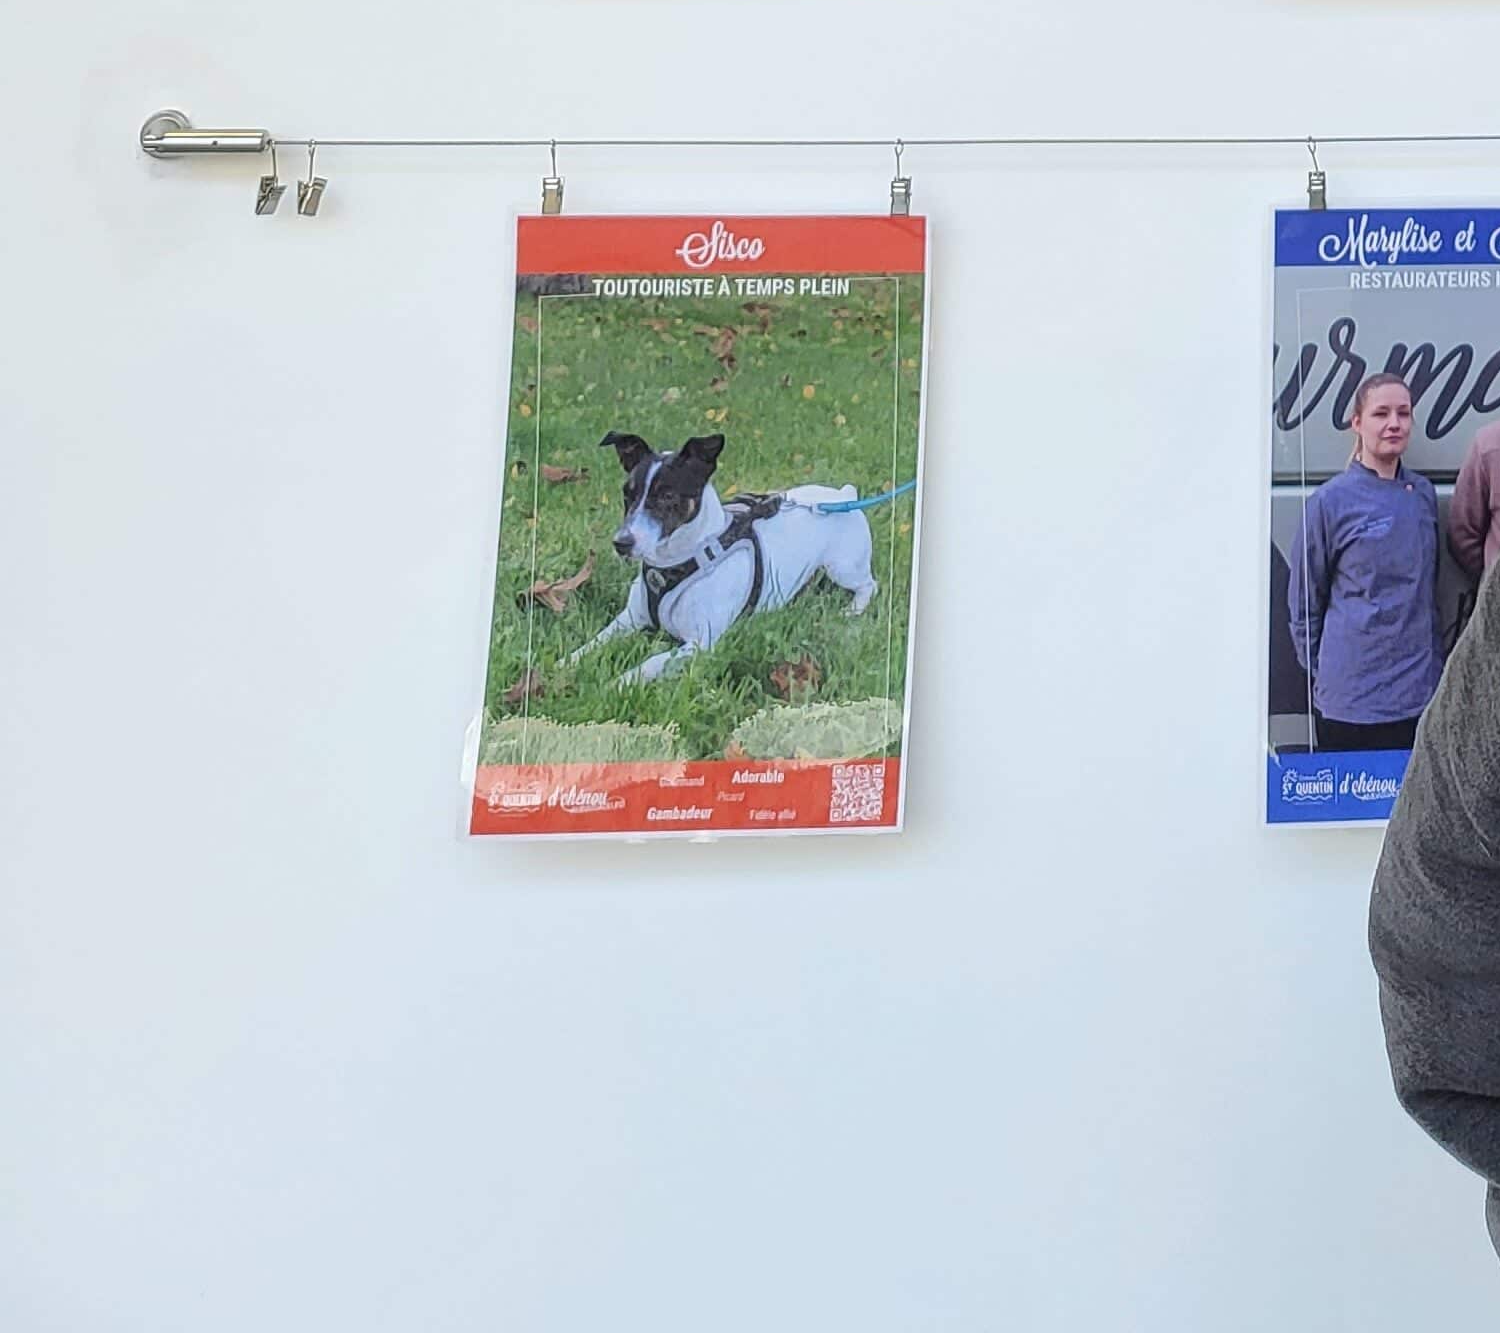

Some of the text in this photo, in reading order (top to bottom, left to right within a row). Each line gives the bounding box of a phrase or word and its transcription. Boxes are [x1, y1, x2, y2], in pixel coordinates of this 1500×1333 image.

[675, 220, 766, 268] Sisco
[1318, 213, 1442, 270] Marylise
[1455, 219, 1477, 252] et
[592, 274, 850, 298] TOUTOURISTE À TEMPS PLEIN
[1349, 269, 1491, 290] RESTAURATEURS
[732, 769, 785, 784] Adorable
[1295, 780, 1333, 797] QUENTIN
[647, 805, 714, 821] Gambadeur
